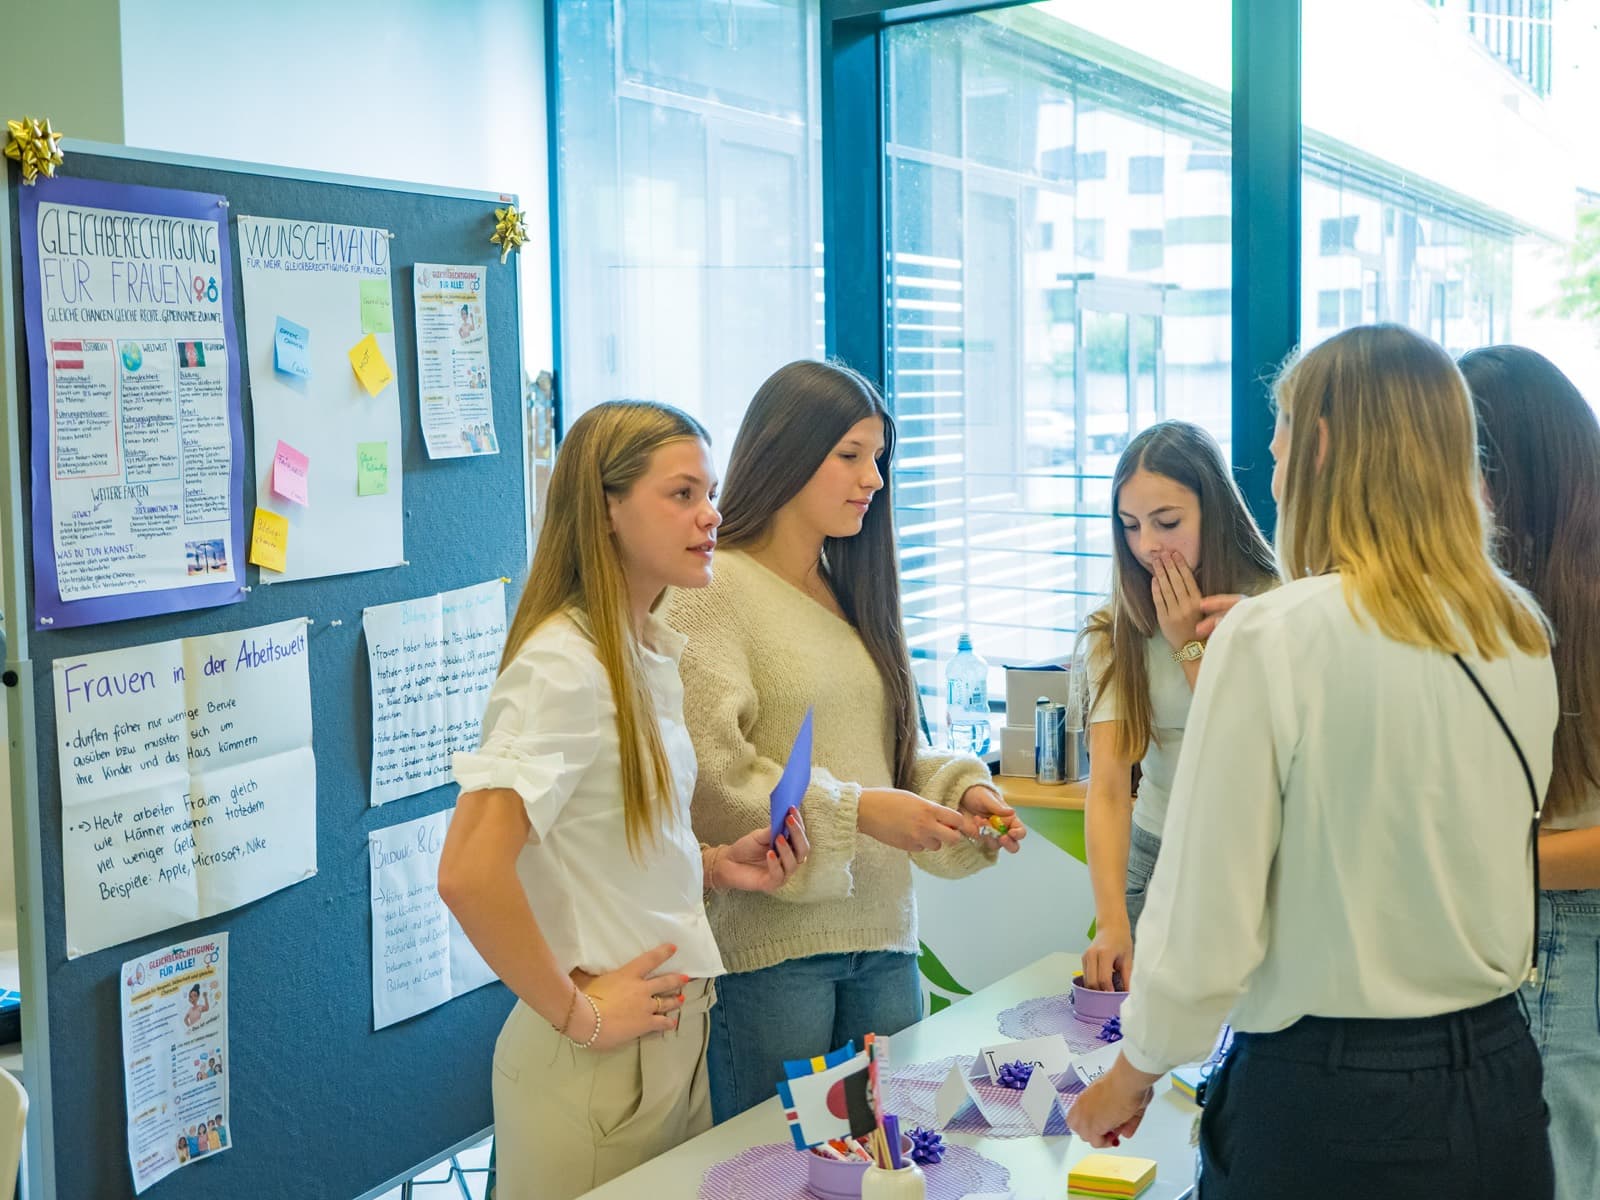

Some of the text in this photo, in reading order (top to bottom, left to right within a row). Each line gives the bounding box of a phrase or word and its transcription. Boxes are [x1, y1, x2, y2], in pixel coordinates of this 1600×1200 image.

[40, 208, 216, 264] GLEICHBERECHTIGUNG
[43, 258, 193, 304] FÜR FRAUEN
[263, 259, 281, 270] MEHR
[284, 260, 349, 273] GLEICHBERECHTIGUNG
[47, 307, 78, 322] GLEICHE
[142, 343, 168, 353] WELTWEIT
[91, 485, 149, 501] WEITERE FAKTEN
[56, 544, 135, 560] WAS DU TUN KANNST
[376, 644, 400, 660] Frauen
[403, 637, 421, 652] haben
[64, 635, 305, 713] Frauen in der Arbeitswelt
[72, 698, 237, 750] durften früher nur wenige Berufe
[73, 749, 110, 767] ausüben
[144, 732, 180, 751] mussten
[190, 726, 210, 740] sich
[220, 721, 234, 733] um
[76, 735, 258, 785] ihre Kinder und das Haus kümmern
[93, 780, 258, 831] Heute arbeiten Frauen gleich
[94, 836, 113, 852] wie
[124, 825, 165, 843] Männer
[225, 800, 265, 820] trotzdem
[97, 835, 196, 874] viel weniger Geld
[158, 861, 191, 884] Apple,
[246, 835, 267, 855] Nike
